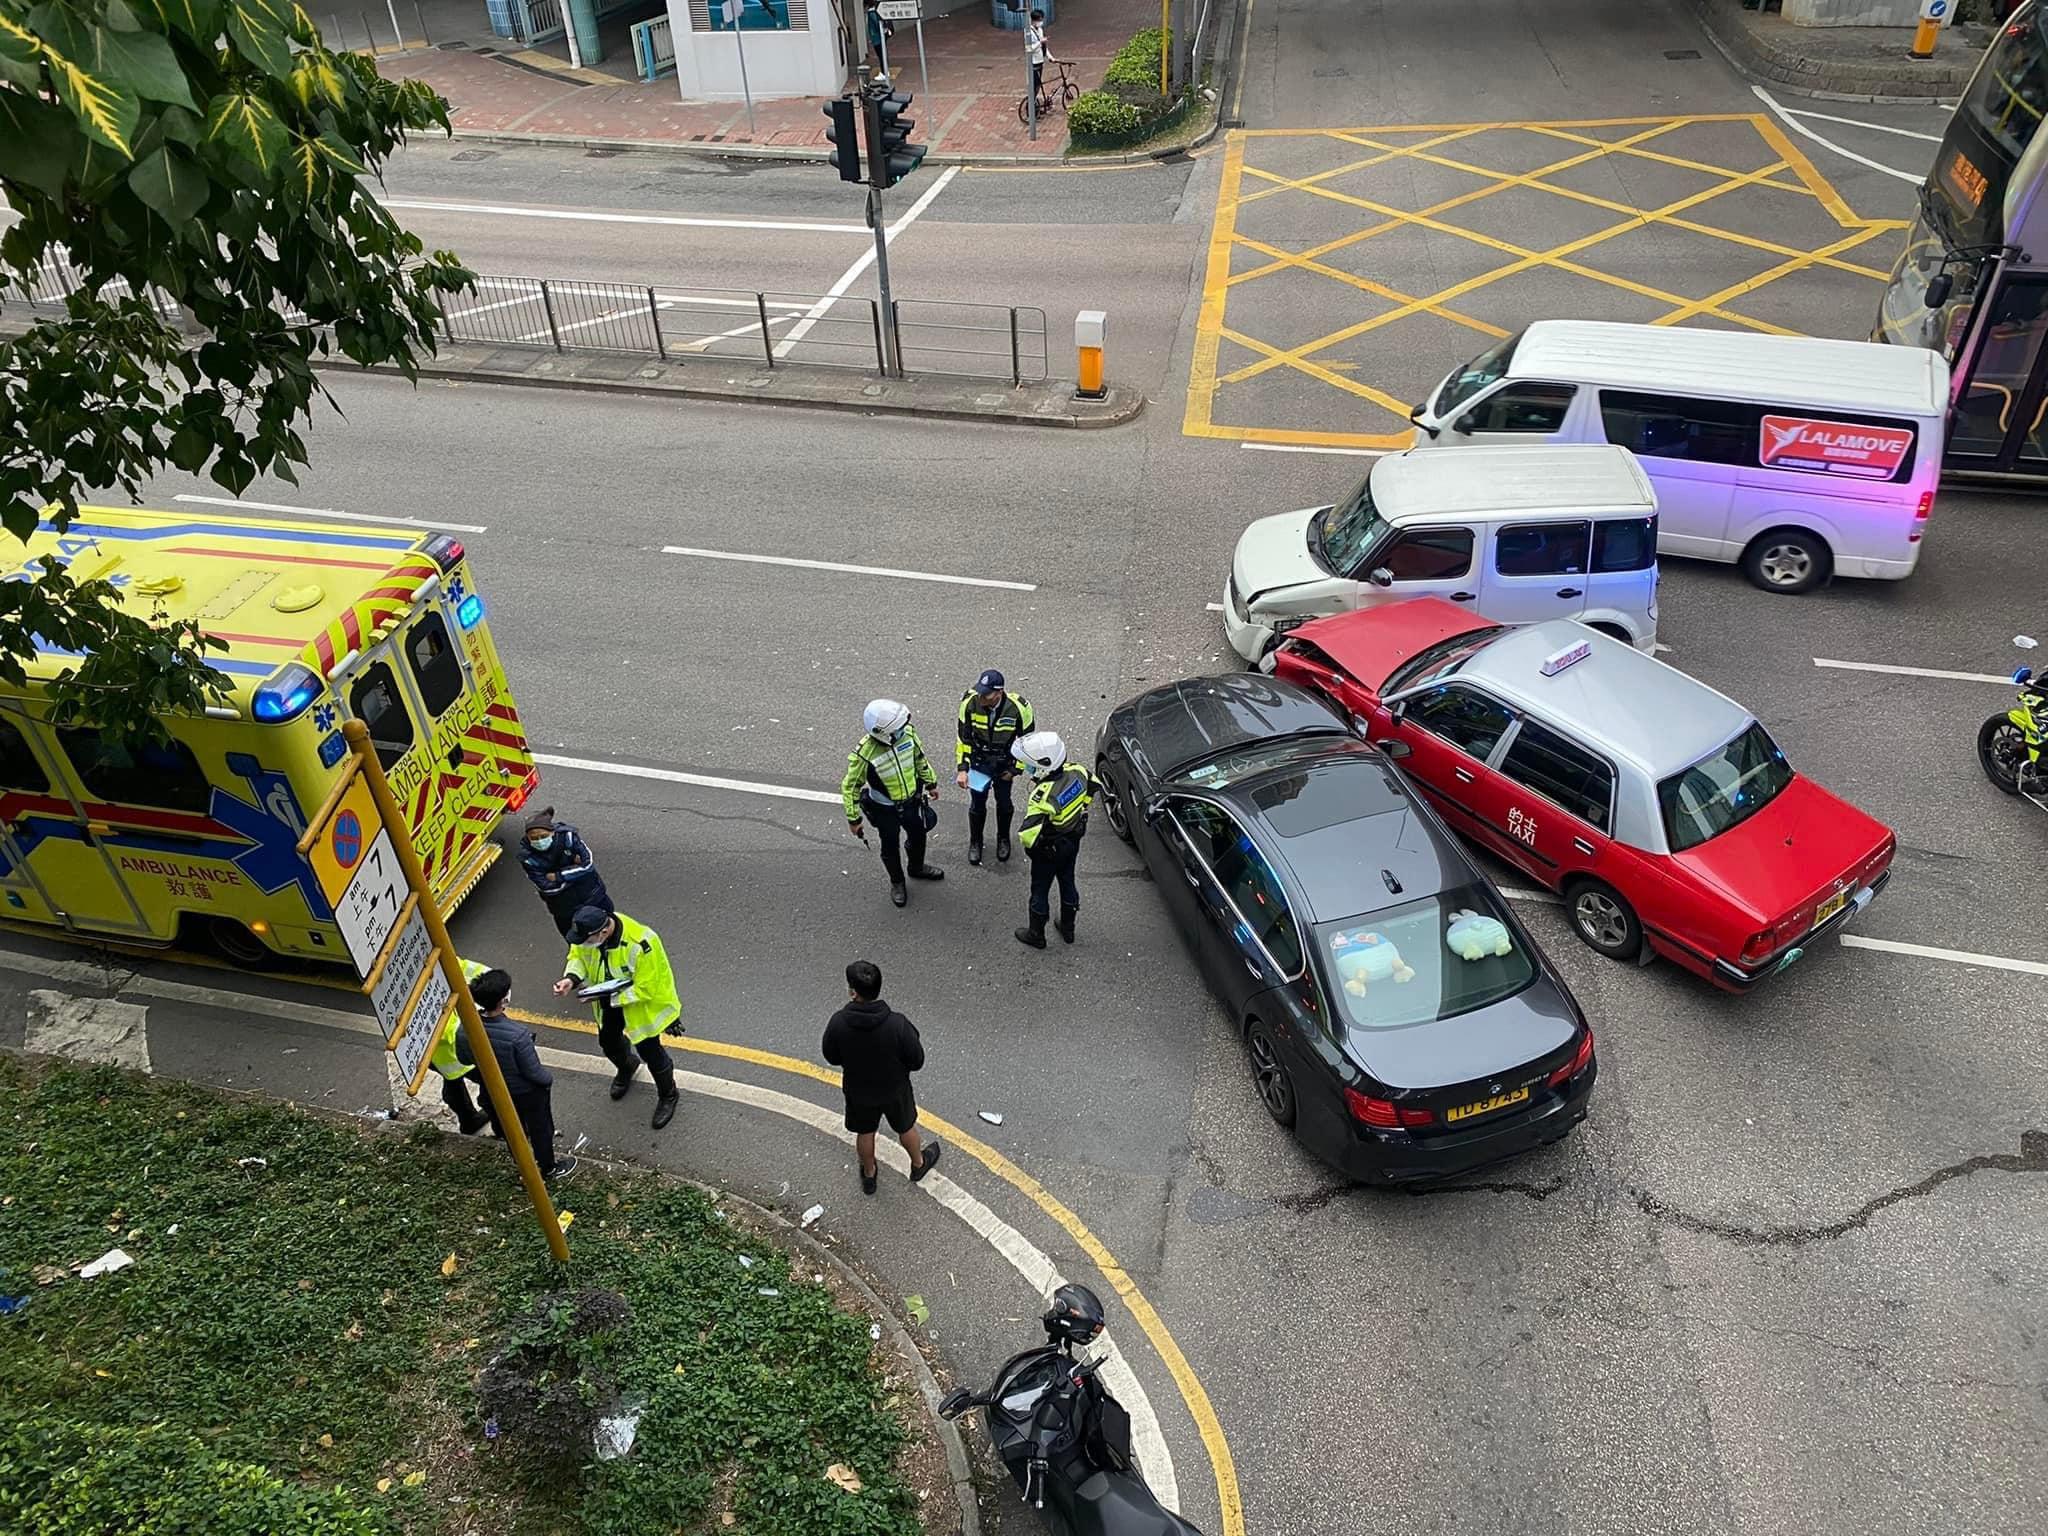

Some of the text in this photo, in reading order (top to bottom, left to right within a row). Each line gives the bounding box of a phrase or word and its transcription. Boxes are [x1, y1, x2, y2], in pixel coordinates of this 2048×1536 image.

[1799, 430, 1905, 453] LALAMOVE
[451, 760, 495, 815] CLEAR
[1507, 818, 1536, 846] TAXI
[1509, 806, 1538, 833] 的士
[120, 856, 243, 886] AMBULANCE
[349, 847, 382, 901] am 7
[165, 879, 215, 901] 救護
[353, 887, 369, 921] 上午
[364, 882, 397, 939] pm 7
[378, 924, 423, 1013] General Holidays
[387, 937, 407, 976] Except
[406, 1001, 424, 1037] Except
